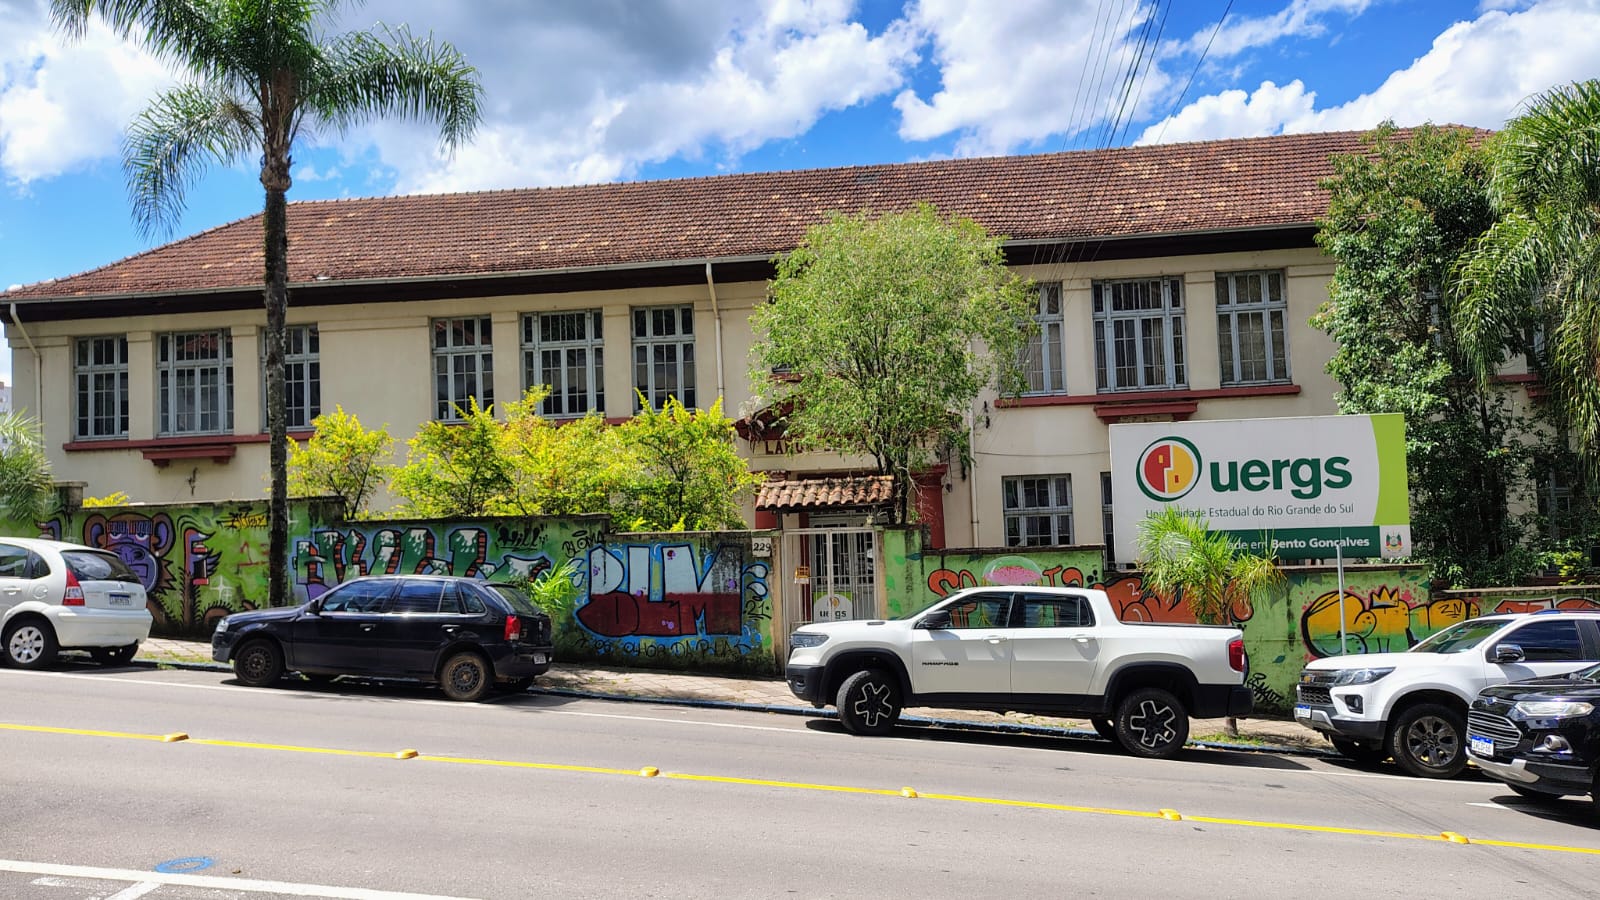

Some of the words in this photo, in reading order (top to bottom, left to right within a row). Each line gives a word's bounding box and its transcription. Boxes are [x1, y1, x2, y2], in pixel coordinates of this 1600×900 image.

[1209, 456, 1353, 500] uergs
[1209, 506, 1250, 517] Estadual
[1252, 505, 1265, 516] do
[1267, 505, 1283, 516] Rio
[1286, 504, 1322, 515] Grande
[1324, 503, 1337, 514] do
[1340, 503, 1354, 514] Sul
[753, 542, 772, 553] 229
[1271, 538, 1306, 549] Bento
[1309, 537, 1370, 549] Gonçalves
